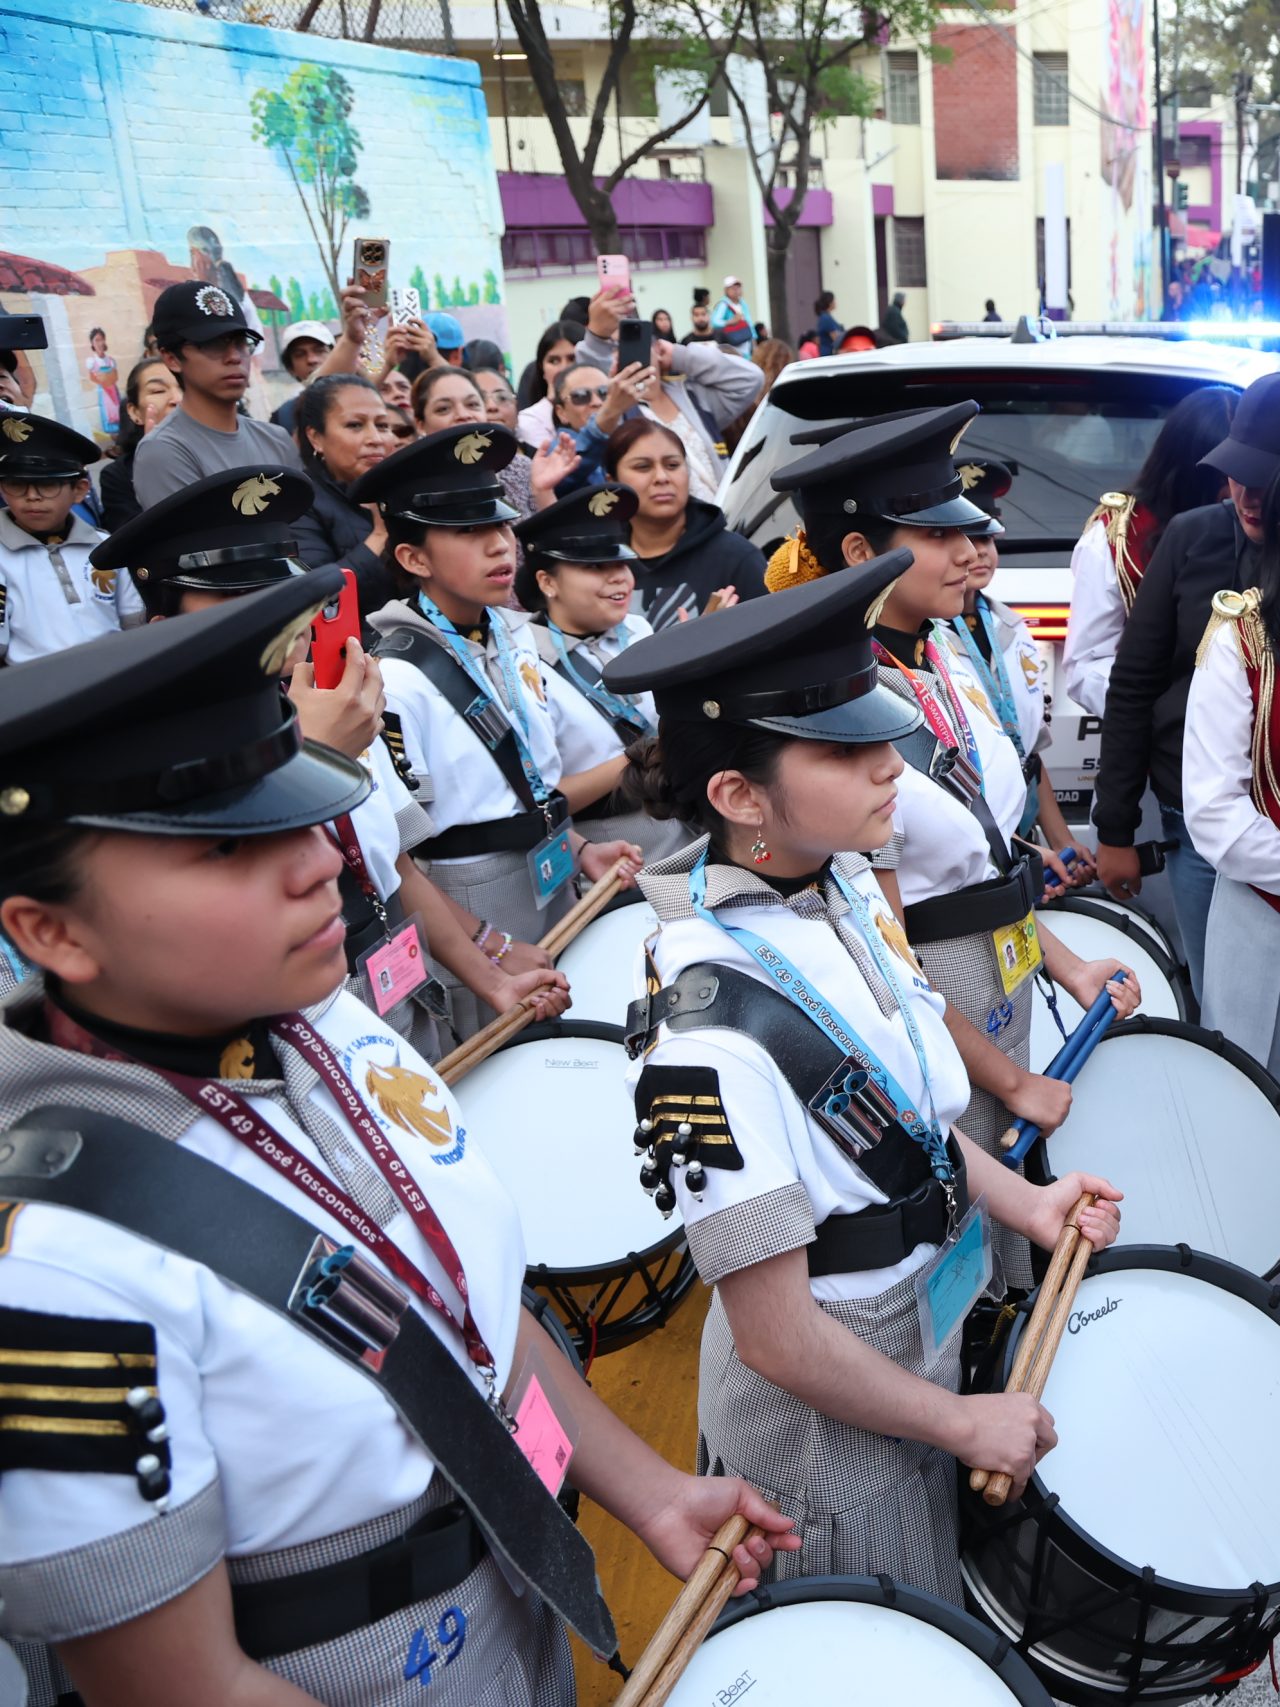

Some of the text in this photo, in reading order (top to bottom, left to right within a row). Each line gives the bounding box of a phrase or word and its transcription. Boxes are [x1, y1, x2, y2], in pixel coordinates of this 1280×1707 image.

[911, 678, 955, 749] ZTE SMARTPHO
[962, 723, 977, 753] ZTE
[755, 944, 782, 968] EST
[775, 968, 793, 984] 49
[986, 999, 1013, 1038] 49
[199, 1084, 238, 1114] EST
[229, 1114, 254, 1134] 49
[389, 1160, 407, 1180] 49
[400, 1183, 426, 1213] EST
[402, 1605, 467, 1687] 49
